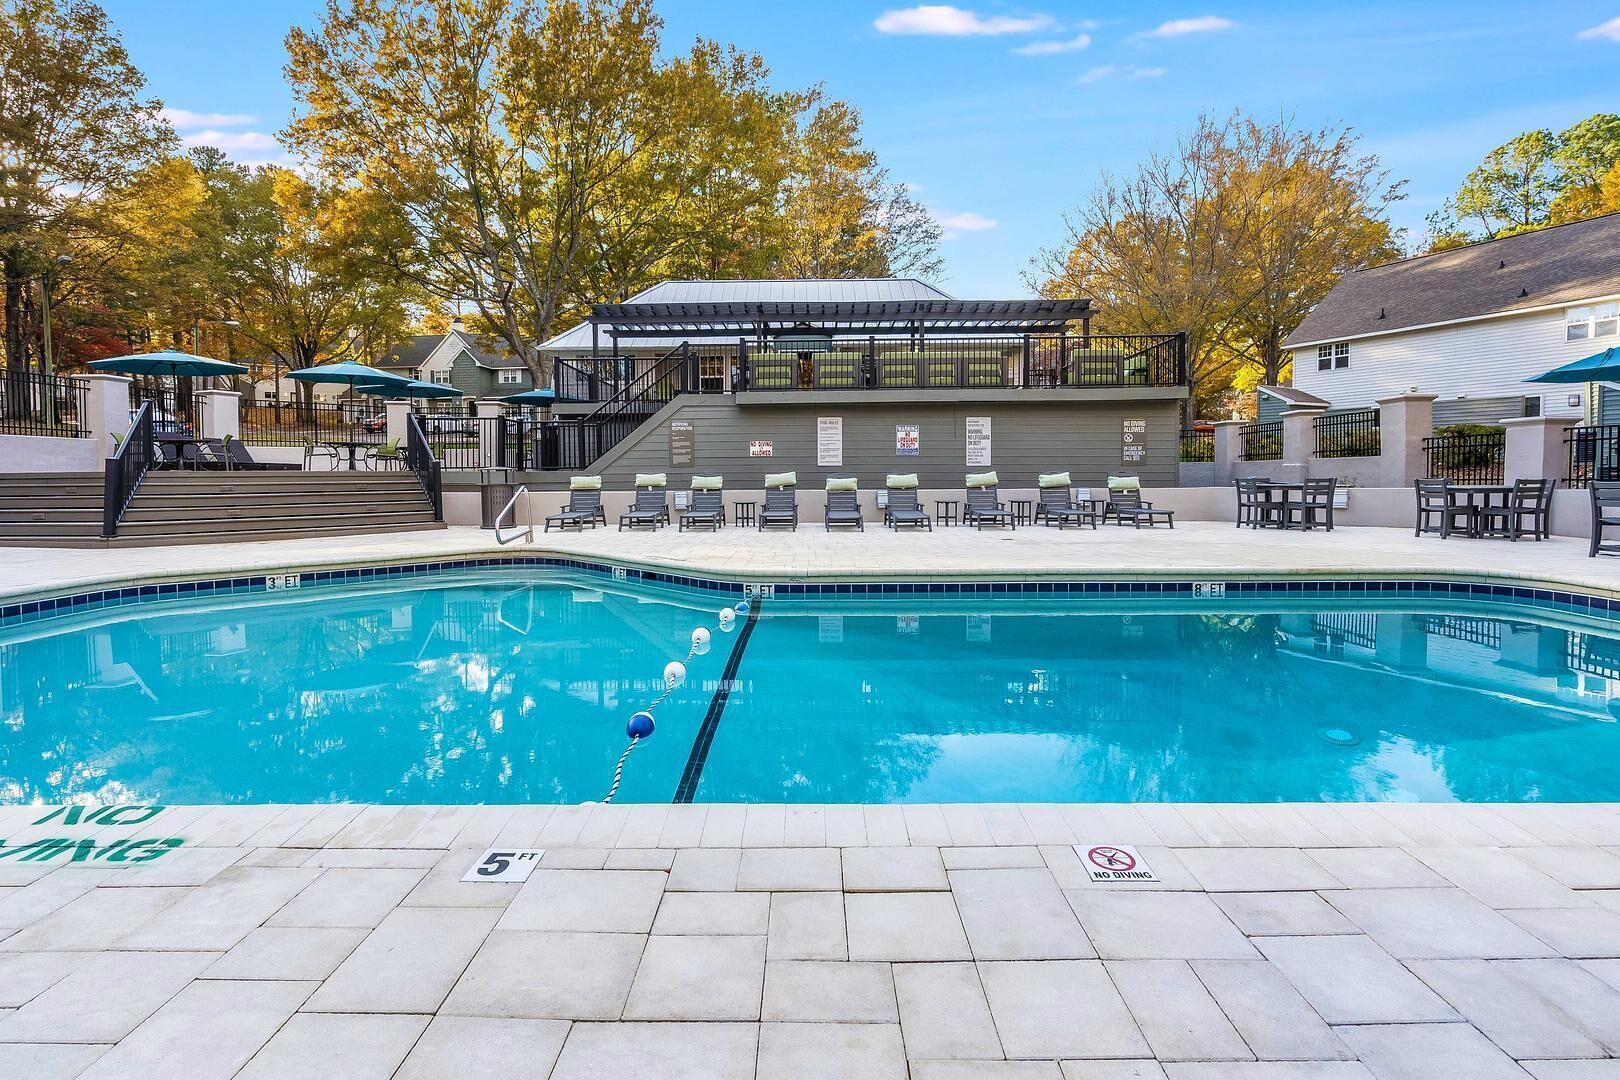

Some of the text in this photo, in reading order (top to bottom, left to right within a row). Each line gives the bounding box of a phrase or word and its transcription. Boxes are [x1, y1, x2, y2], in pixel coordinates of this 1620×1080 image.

[32, 805, 167, 825] NO
[477, 852, 538, 876] 5 FT
[1093, 871, 1152, 879] NO DIVING
